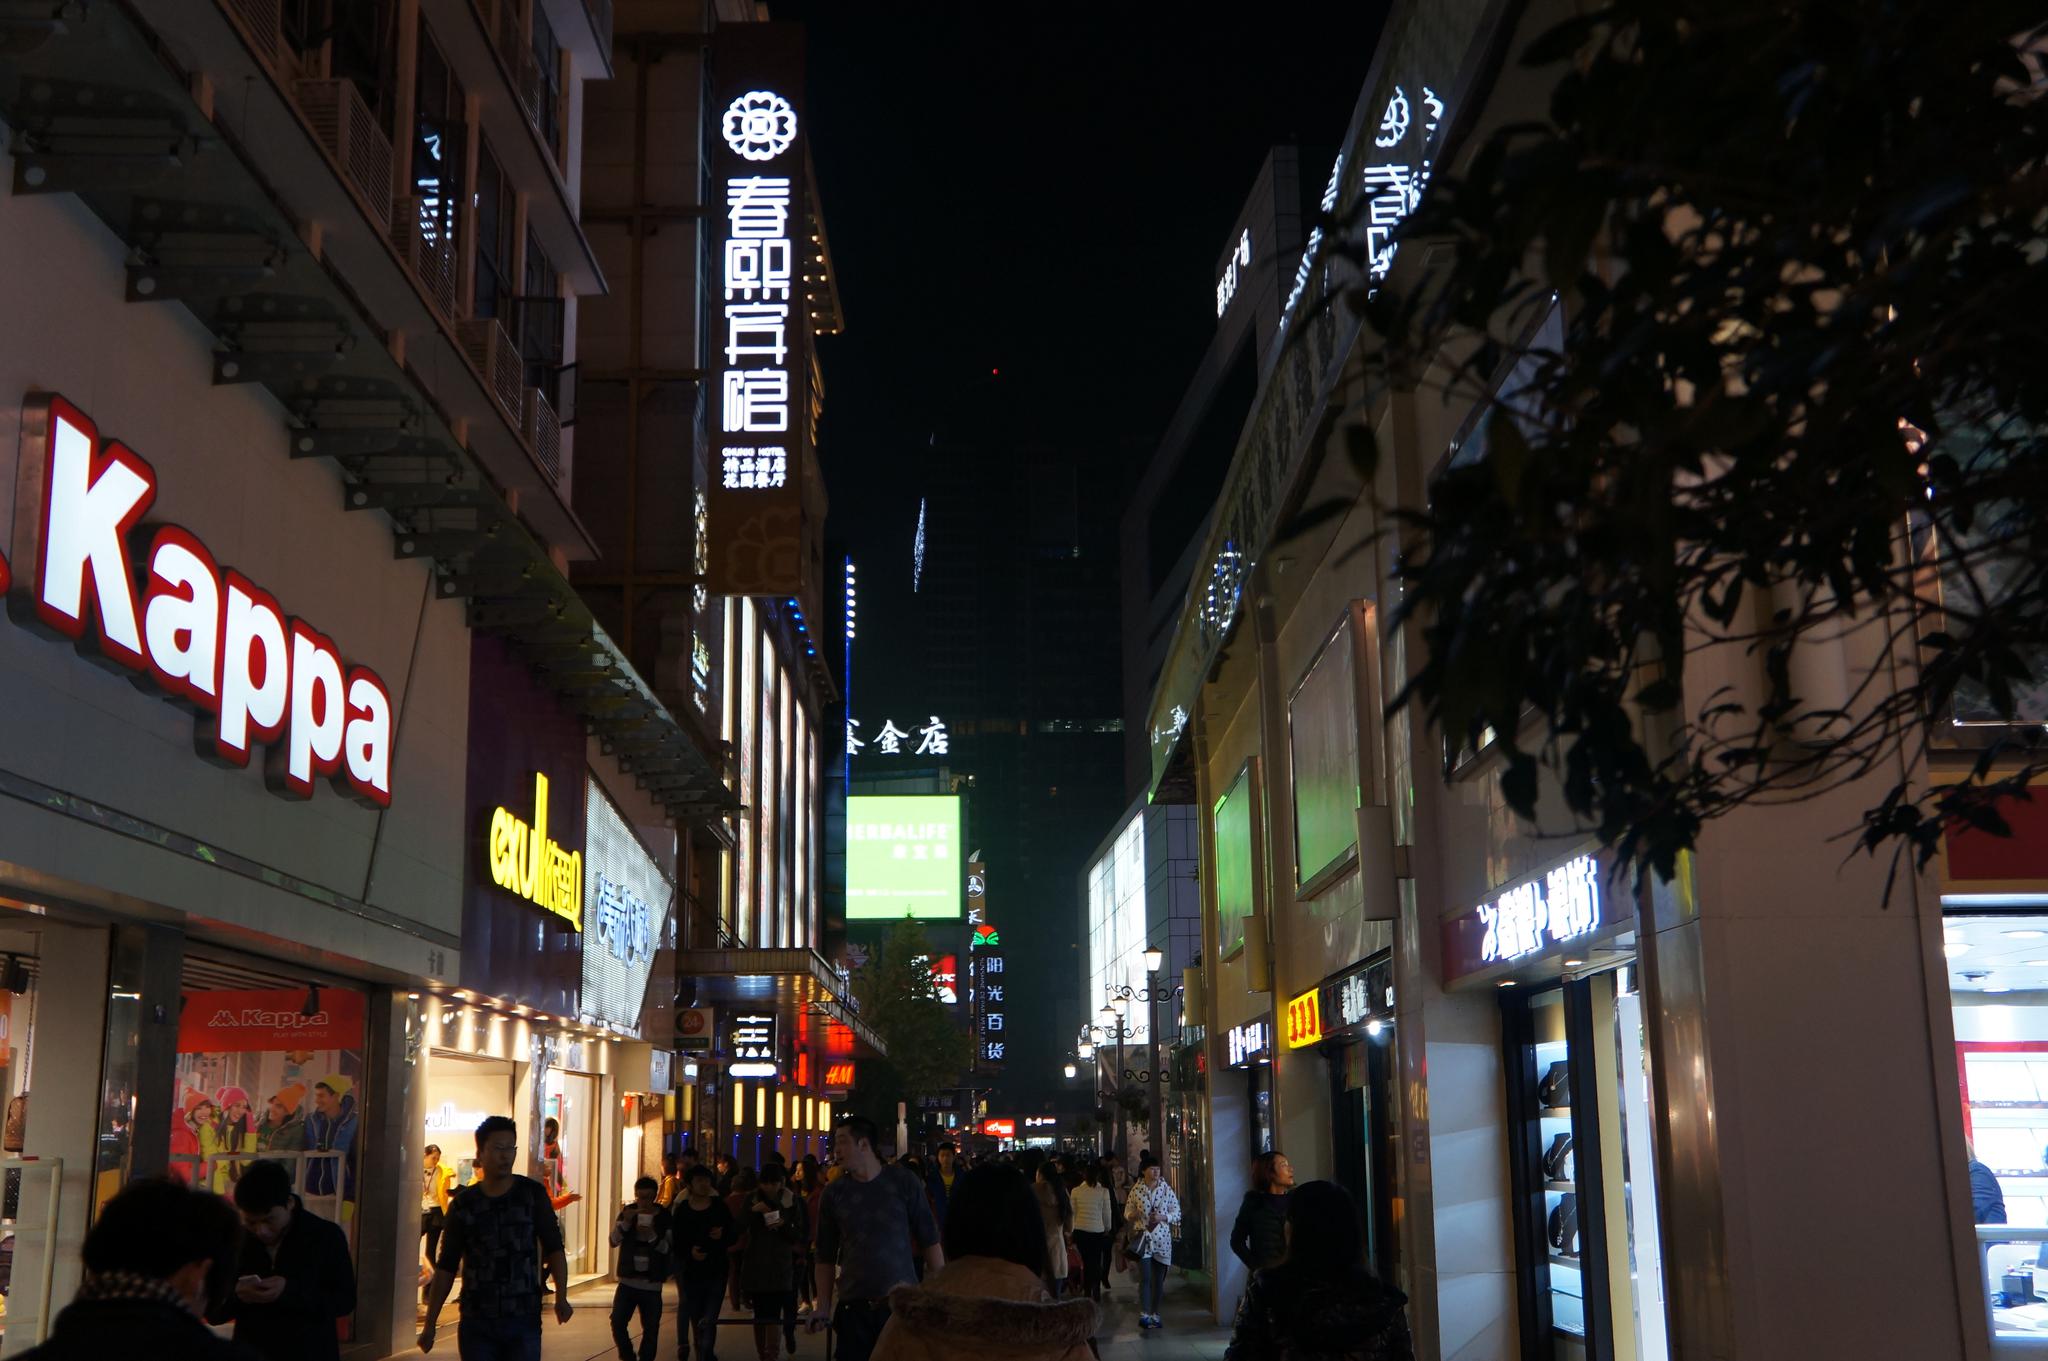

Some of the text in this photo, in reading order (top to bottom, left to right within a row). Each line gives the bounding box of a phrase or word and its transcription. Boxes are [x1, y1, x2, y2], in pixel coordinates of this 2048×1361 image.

[723, 176, 792, 433] 春熙宾馆
[43, 415, 391, 794] Kappa
[241, 1009, 329, 1029] Kappa
[986, 957, 1005, 1060] 阳光百货
